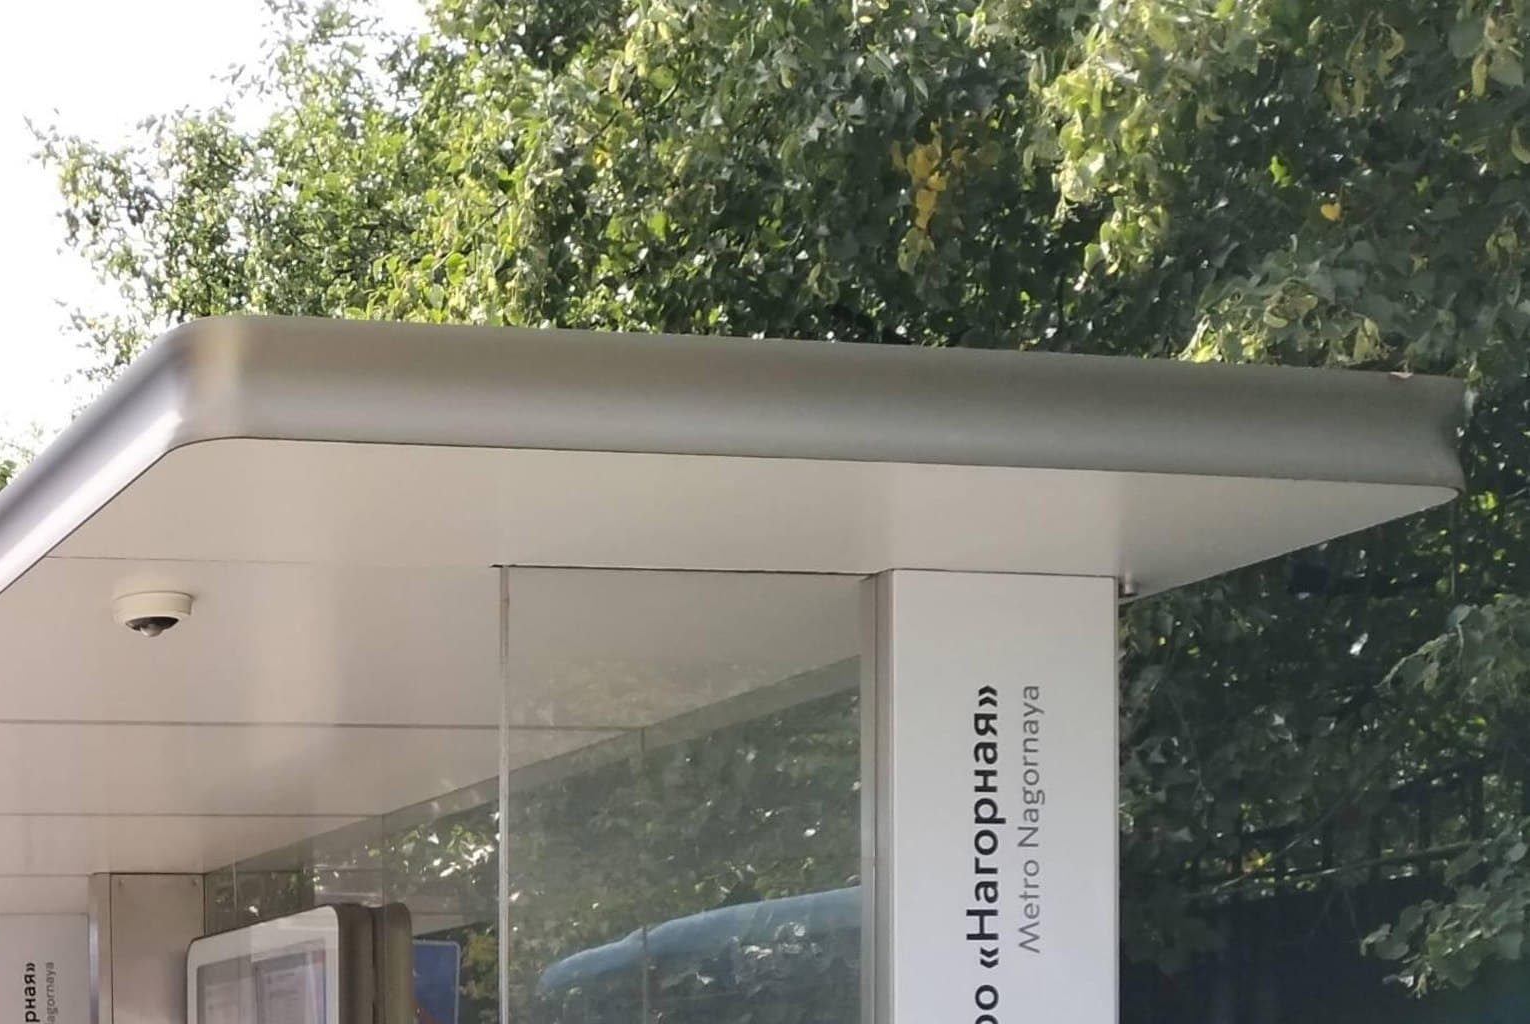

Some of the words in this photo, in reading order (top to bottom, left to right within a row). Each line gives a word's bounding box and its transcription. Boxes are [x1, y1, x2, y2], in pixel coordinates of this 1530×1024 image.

[966, 685, 1007, 968] «Нагорная»
[1017, 685, 1046, 847] Nagornaya
[1018, 859, 1040, 953] Metro
